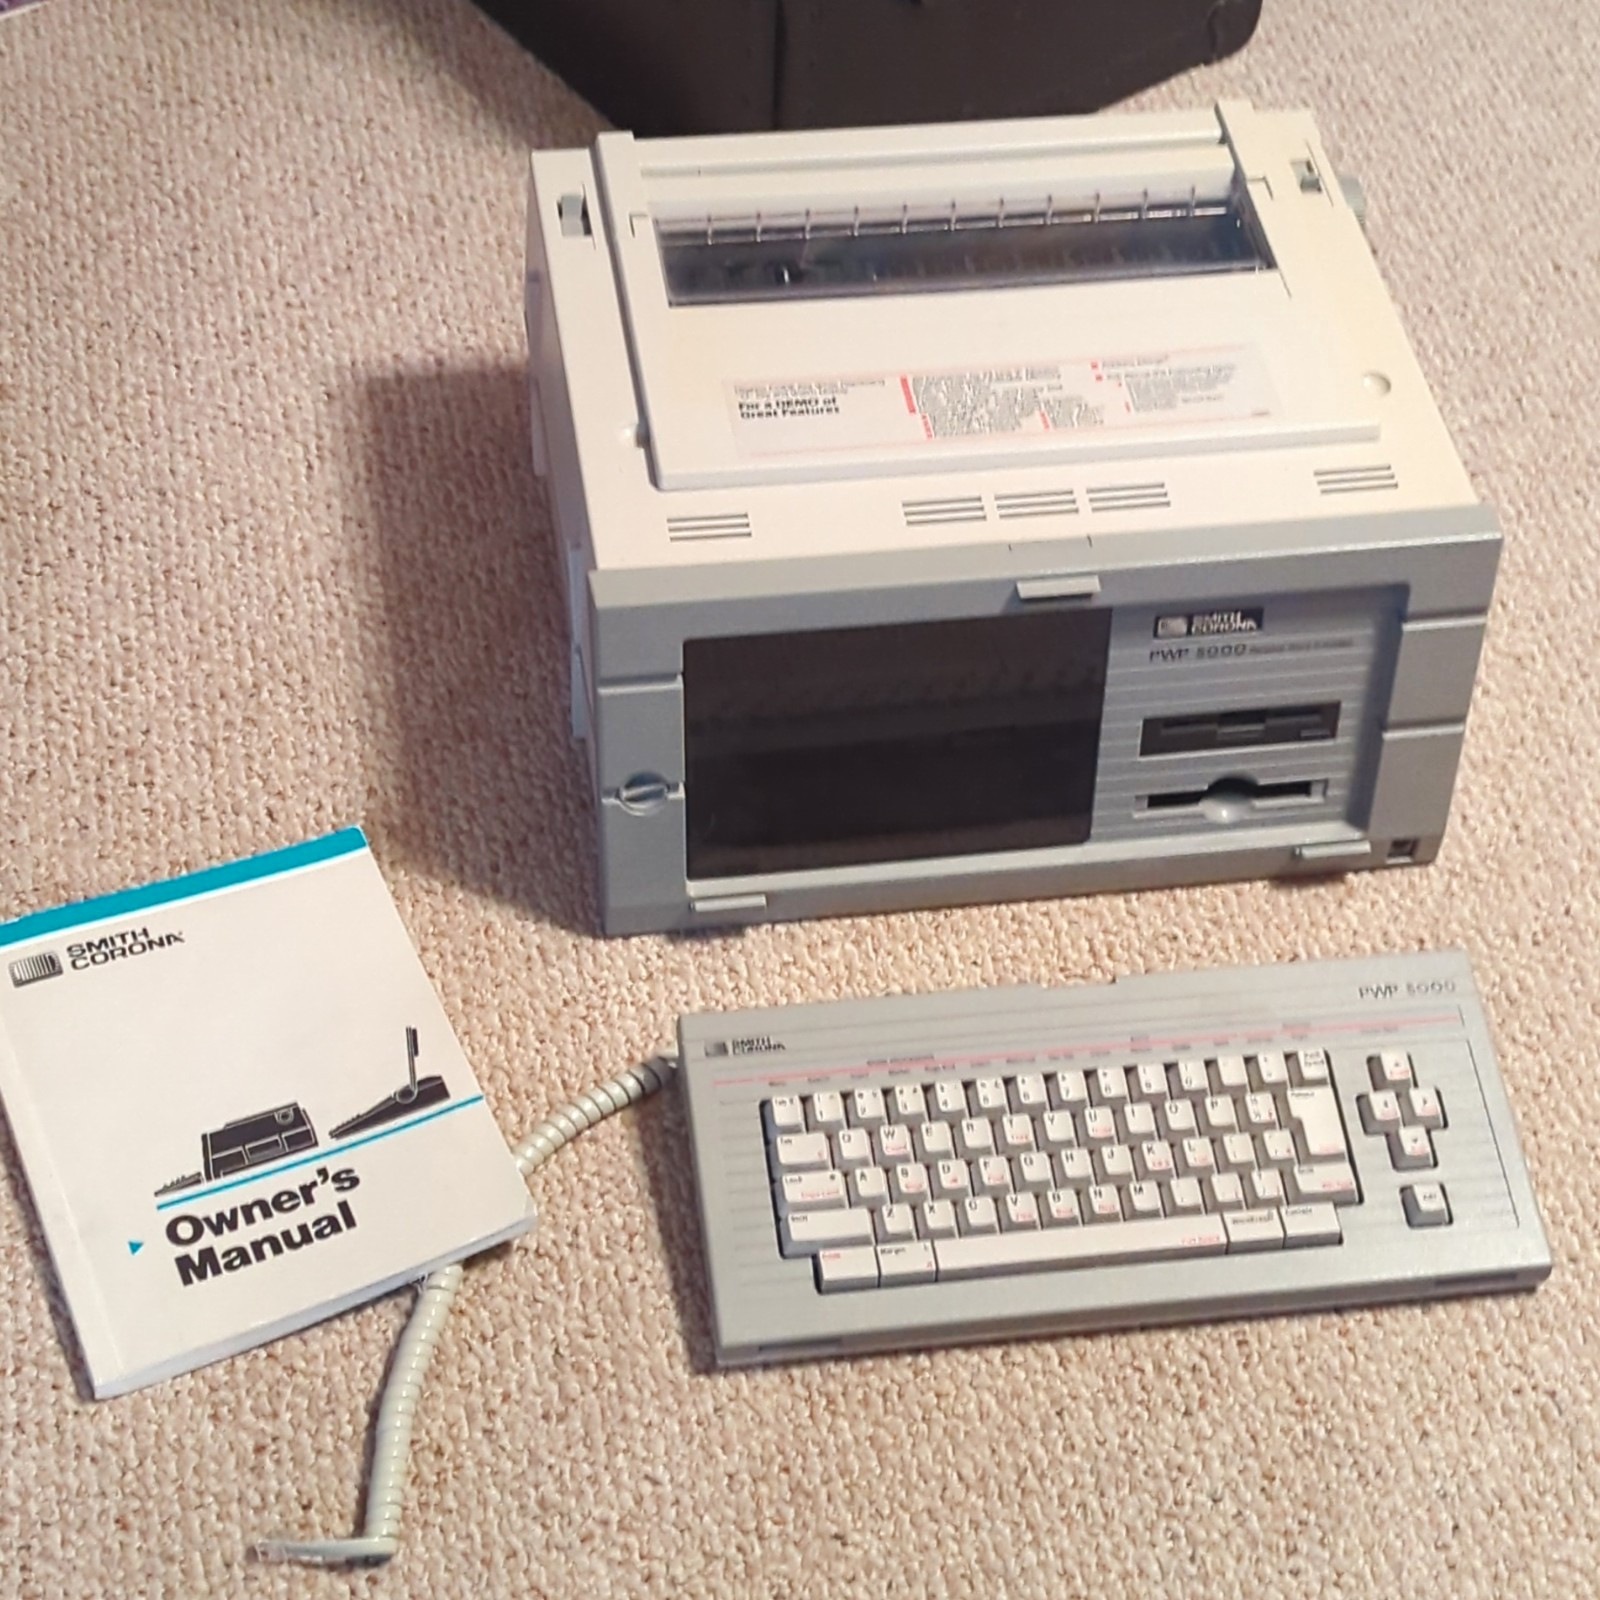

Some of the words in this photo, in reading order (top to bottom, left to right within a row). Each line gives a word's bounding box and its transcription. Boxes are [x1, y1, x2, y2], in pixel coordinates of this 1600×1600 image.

[740, 409, 778, 419] Great
[781, 406, 840, 417] Features
[776, 399, 819, 410] DEMO
[66, 926, 151, 958] SMITH
[70, 932, 185, 971] CORONA
[165, 1166, 361, 1247] Owner's
[174, 1199, 358, 1287] Manual
